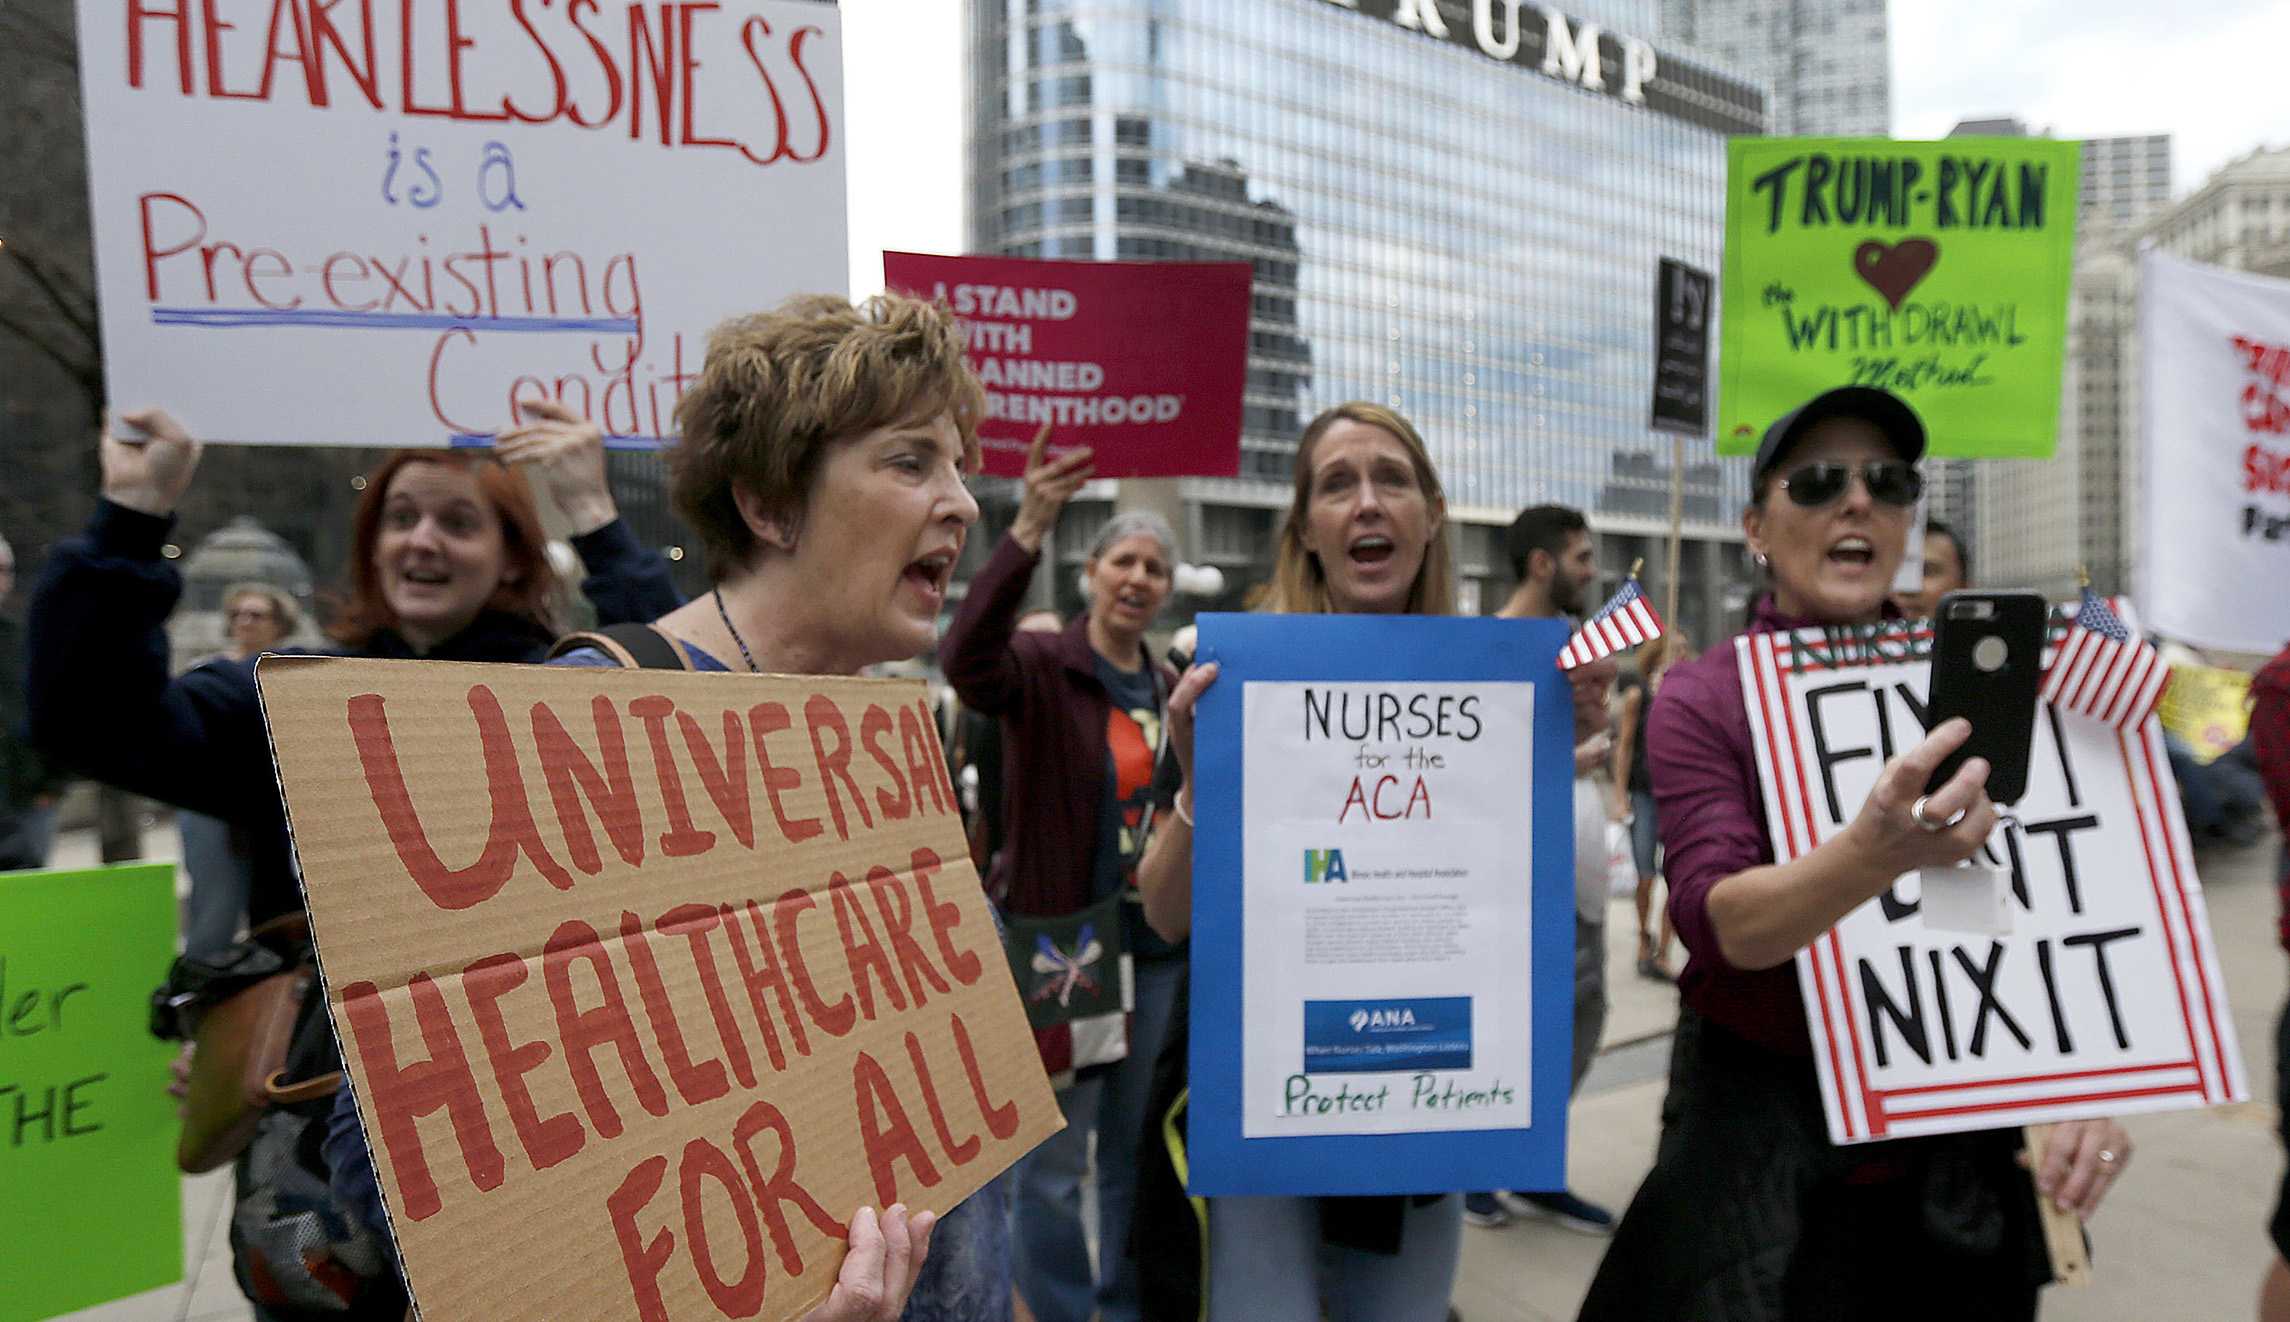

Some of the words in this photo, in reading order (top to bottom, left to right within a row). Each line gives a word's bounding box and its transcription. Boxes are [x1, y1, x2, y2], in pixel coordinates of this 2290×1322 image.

[1325, 0, 1657, 103] RUMP
[380, 130, 443, 211] is
[478, 141, 526, 211] a
[1753, 153, 2047, 234] TRUMP-RYAN
[140, 193, 643, 376] Pre-existing
[954, 283, 1080, 321] STAND
[429, 326, 702, 440] Condit
[962, 355, 1104, 391] ANNED
[984, 390, 1181, 426] RENTHOOD
[1304, 688, 1483, 743] NURSES
[1355, 744, 1390, 770] for
[1402, 746, 1447, 770] the
[1339, 774, 1432, 825] ACA
[1303, 848, 1348, 884] IHA
[342, 847, 982, 1221] HEALTHCARE
[1370, 1008, 1416, 1027] ANA
[1284, 1074, 1389, 1116] Protect
[1411, 1073, 1514, 1111] Patients
[605, 1099, 848, 1322] FOR
[852, 1012, 1019, 1210] ALL
